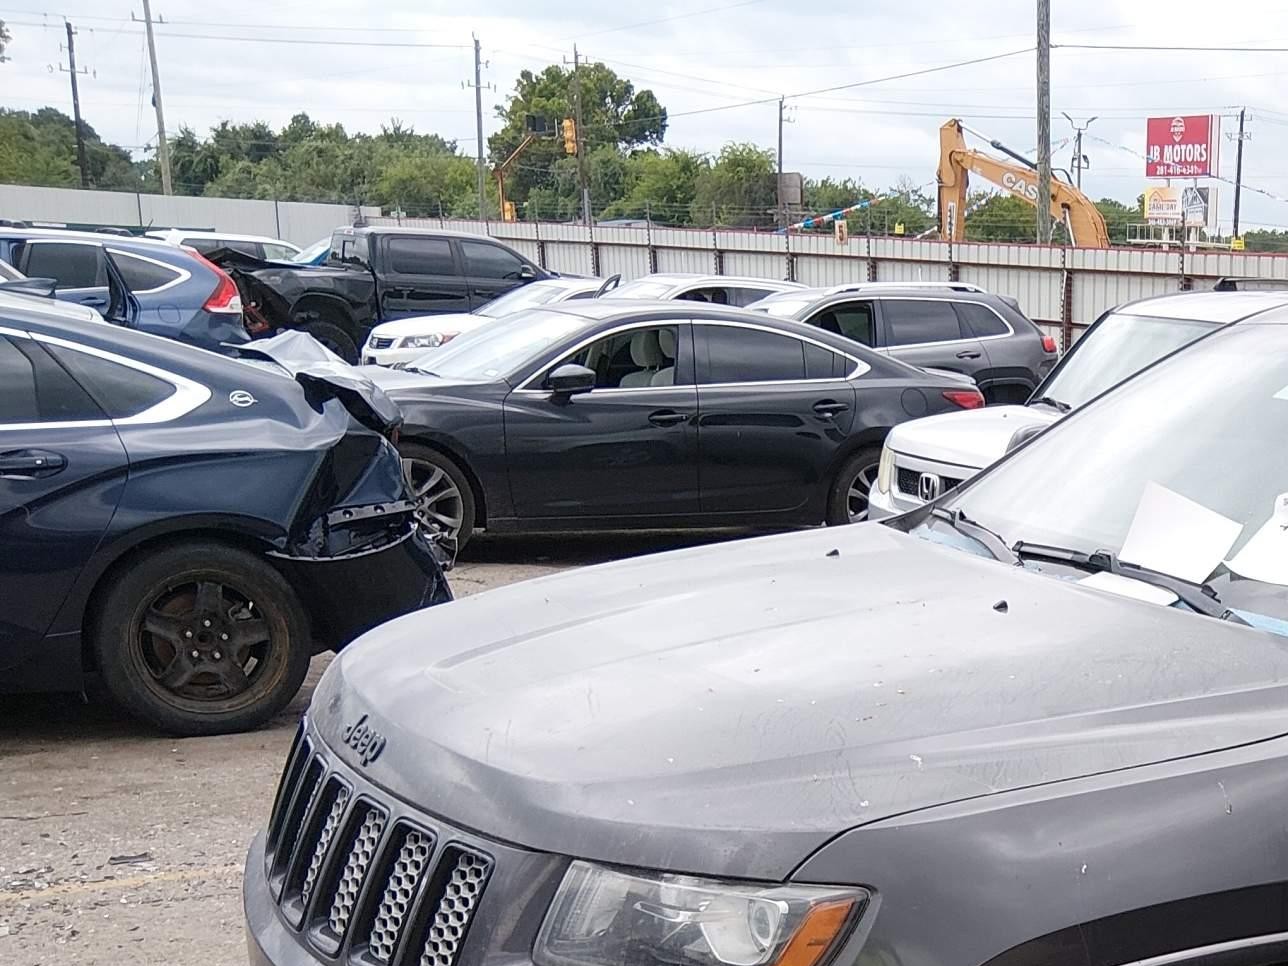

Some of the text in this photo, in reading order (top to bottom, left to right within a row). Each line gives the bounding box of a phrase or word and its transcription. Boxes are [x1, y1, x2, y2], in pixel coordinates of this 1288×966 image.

[1149, 143, 1207, 164] JB MOTORS
[1002, 172, 1041, 200] CAS
[838, 224, 844, 241] 5
[341, 713, 387, 768] Jeep
